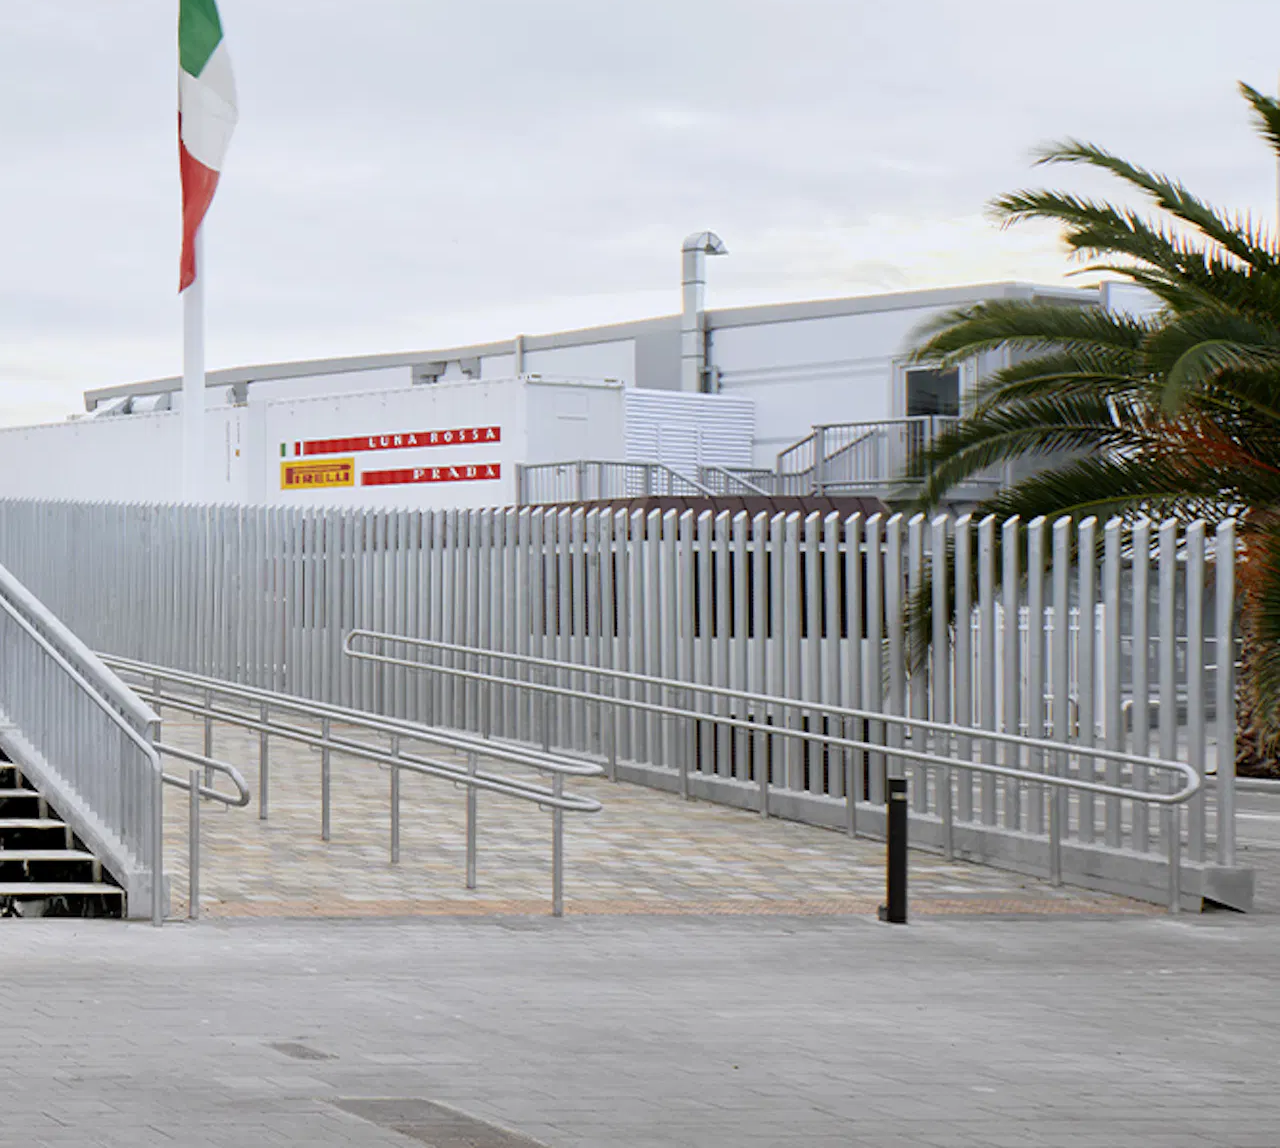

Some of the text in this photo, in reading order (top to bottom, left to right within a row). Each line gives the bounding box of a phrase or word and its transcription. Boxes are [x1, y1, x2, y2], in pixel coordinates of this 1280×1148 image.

[368, 427, 496, 448] LUNA ROSSA
[285, 463, 351, 485] PIRELLI
[413, 465, 496, 480] PRADA
